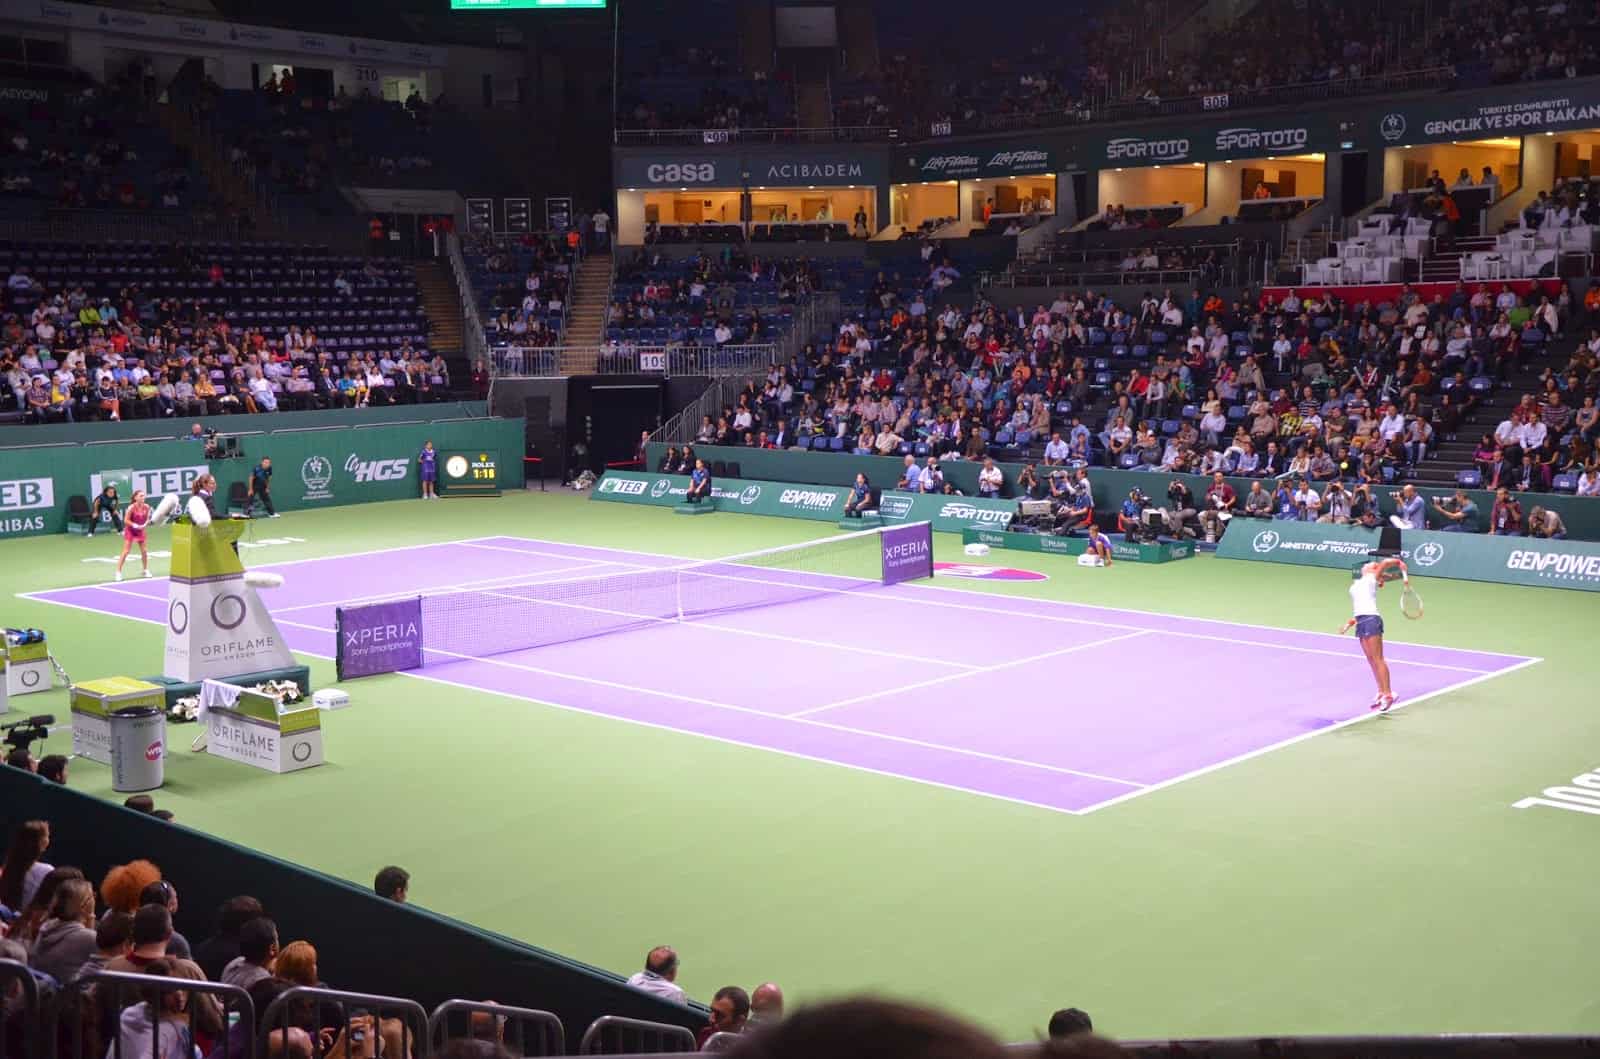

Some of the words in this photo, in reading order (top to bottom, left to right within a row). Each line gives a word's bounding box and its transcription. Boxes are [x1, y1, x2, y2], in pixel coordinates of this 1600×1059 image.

[1485, 115, 1503, 128] VE
[1504, 111, 1543, 127] SPOR
[1546, 104, 1600, 123] BAKAN
[648, 164, 715, 182] casa
[768, 165, 862, 177] ACIBADEM
[355, 458, 410, 482] HGS
[619, 481, 643, 492] TEB
[779, 489, 836, 507] GENPOWER
[885, 540, 929, 560] XPERIA
[1507, 550, 1600, 575] GENPOWE
[345, 621, 417, 647] XPERIA
[201, 637, 273, 656] ORIFLAME
[212, 723, 274, 752] ORIFLAME
